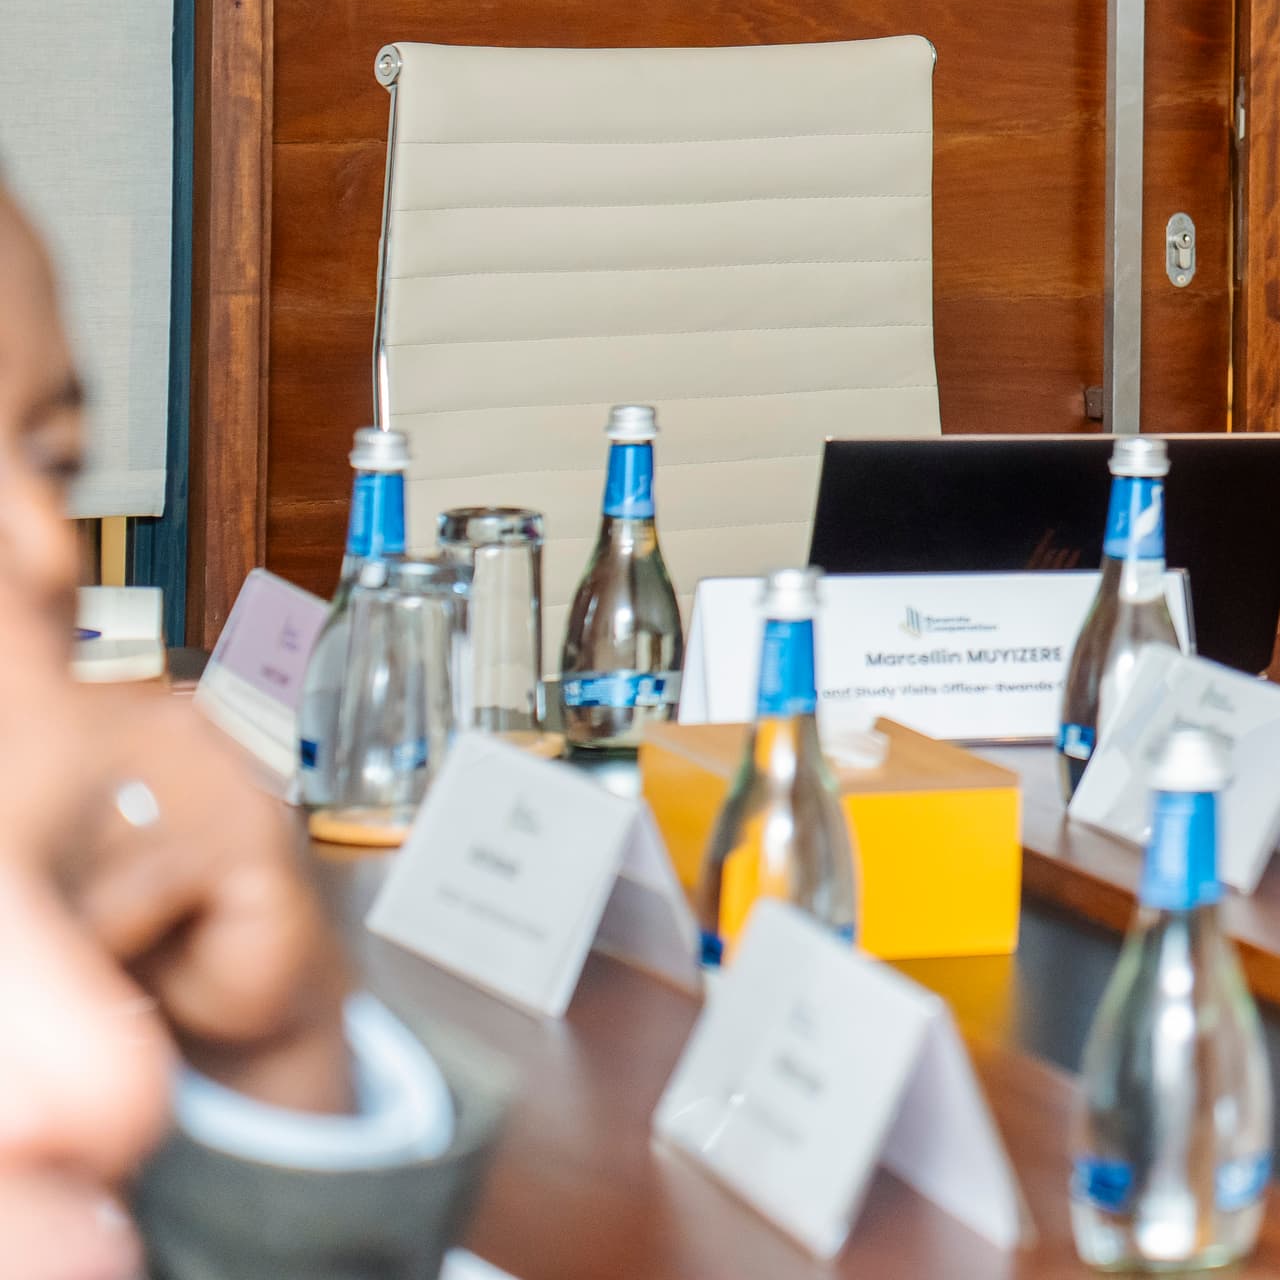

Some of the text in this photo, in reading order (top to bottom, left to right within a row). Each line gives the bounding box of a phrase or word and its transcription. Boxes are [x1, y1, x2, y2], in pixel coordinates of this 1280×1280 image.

[865, 645, 1063, 667] Marcellin MUYIZERE
[854, 685, 896, 701] Study
[901, 683, 938, 697] Visits
